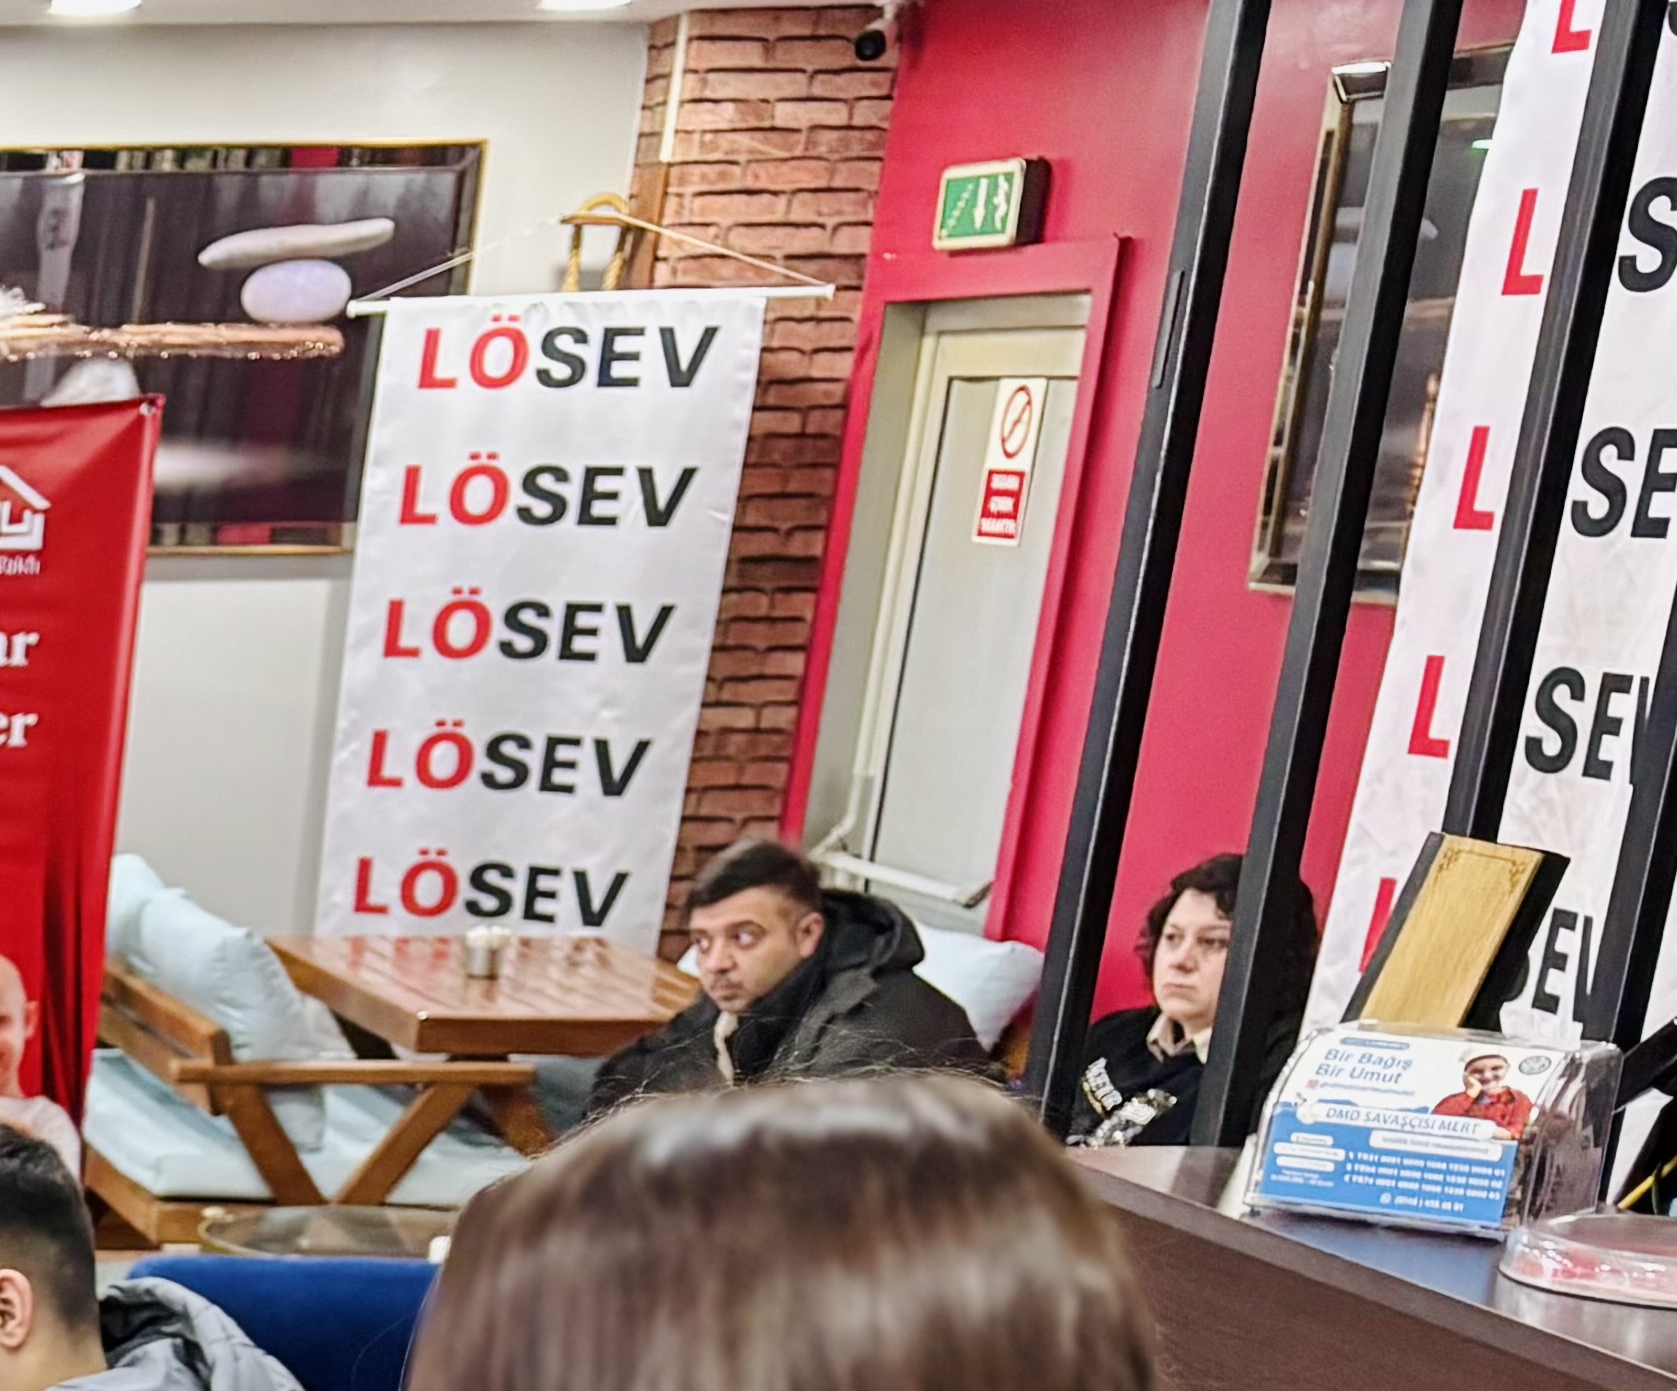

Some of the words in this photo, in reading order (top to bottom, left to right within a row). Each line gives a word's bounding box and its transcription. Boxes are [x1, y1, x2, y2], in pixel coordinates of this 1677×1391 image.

[417, 315, 719, 391] LÖSEV
[398, 452, 698, 527] LÖSEV
[383, 587, 676, 664] LÖSEV
[366, 720, 652, 797] LÖSEV
[353, 848, 630, 928] LÖSEV
[1315, 1063, 1344, 1077] Bir
[1349, 1066, 1403, 1084] Umut
[1324, 1048, 1354, 1062] Bir
[1325, 1107, 1362, 1121] DMD
